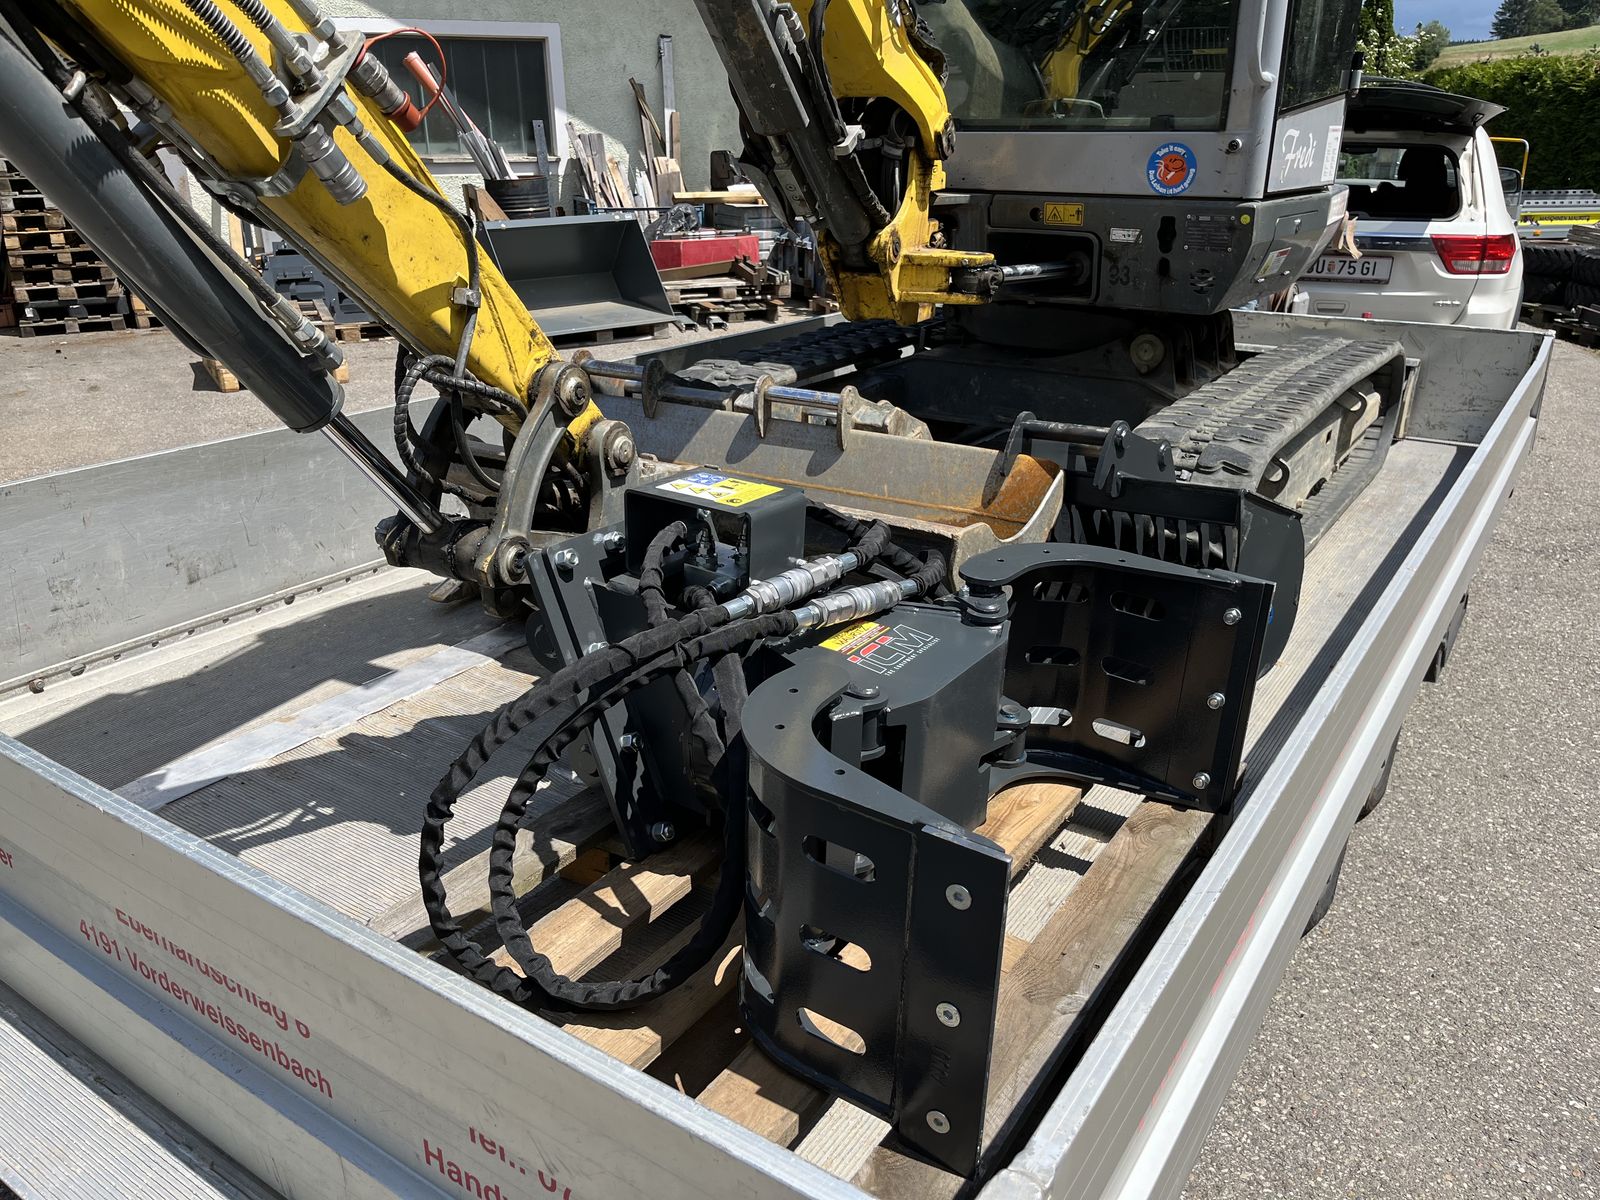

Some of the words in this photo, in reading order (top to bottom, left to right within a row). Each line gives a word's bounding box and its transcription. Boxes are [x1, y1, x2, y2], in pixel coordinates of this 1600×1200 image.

[1282, 128, 1317, 178] Fredi
[1337, 259, 1357, 276] 75
[1360, 260, 1377, 276] GI
[79, 919, 123, 961] 4191
[125, 946, 333, 1098] Vorderweissenbach
[423, 1138, 508, 1200] Hand
